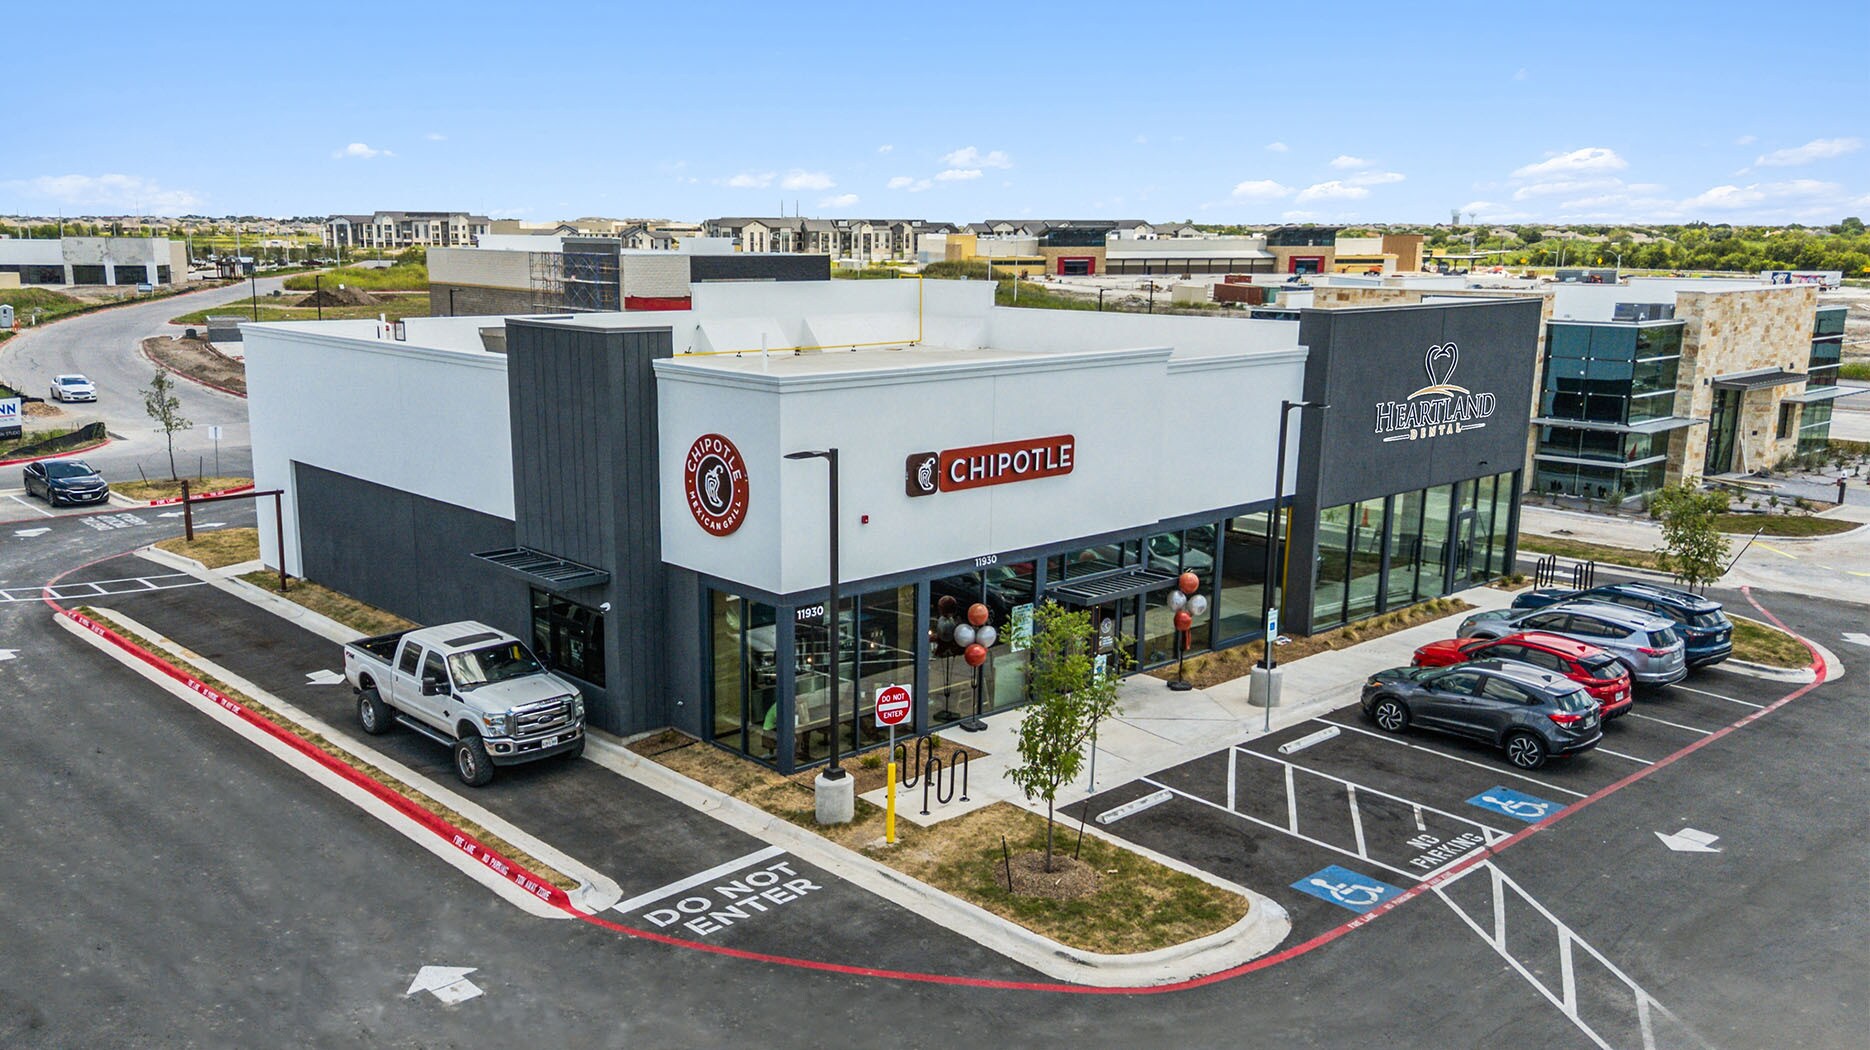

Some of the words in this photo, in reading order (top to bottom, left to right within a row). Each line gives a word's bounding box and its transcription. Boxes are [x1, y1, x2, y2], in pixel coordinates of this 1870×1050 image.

[1409, 422, 1462, 440] DENTAL
[687, 438, 742, 482] CHIPOTLE
[950, 444, 1072, 483] CHIPOTLE
[689, 491, 721, 530] MEXICAN
[723, 501, 741, 529] GRILL
[974, 555, 998, 567] 11930
[796, 605, 824, 620] 11930
[881, 695, 891, 703] DO
[893, 692, 905, 701] NOT
[883, 709, 904, 719] ENTER
[1406, 834, 1440, 850] NO
[1409, 832, 1485, 869] PARKING
[642, 896, 713, 928] DO
[713, 861, 798, 900] NOT
[683, 878, 824, 936] ENTER
